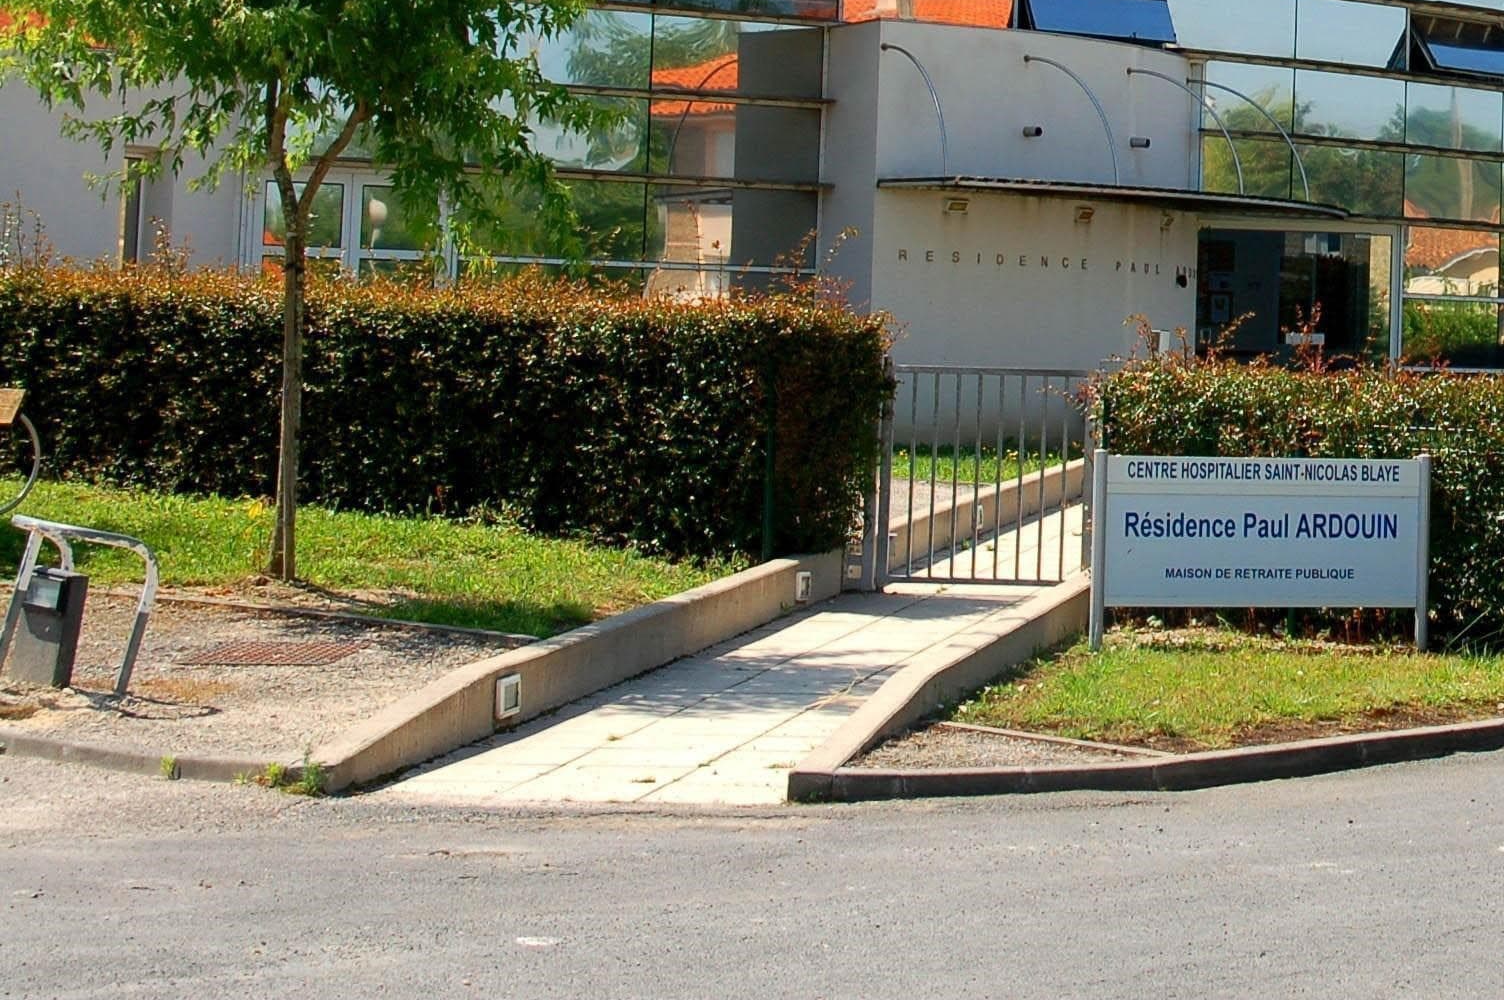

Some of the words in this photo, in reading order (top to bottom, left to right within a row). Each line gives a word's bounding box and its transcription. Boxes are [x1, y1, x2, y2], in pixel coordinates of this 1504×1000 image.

[898, 249, 1088, 270] RESIDENCE
[1115, 261, 1160, 275] PAUL
[1128, 461, 1177, 478] CENTRE
[1181, 462, 1261, 480] HOSPITALIER
[1264, 463, 1358, 481] SAINT-NICOLAS
[1361, 465, 1400, 481] BLAYE
[1125, 511, 1236, 538] Résidence
[1243, 512, 1289, 538] Paul
[1296, 513, 1398, 539] ARDOUIN
[1165, 567, 1212, 579] MAISON
[1216, 568, 1231, 579] DE
[1235, 568, 1292, 580] RETRAITE
[1295, 568, 1355, 581] PUBLIQUE
